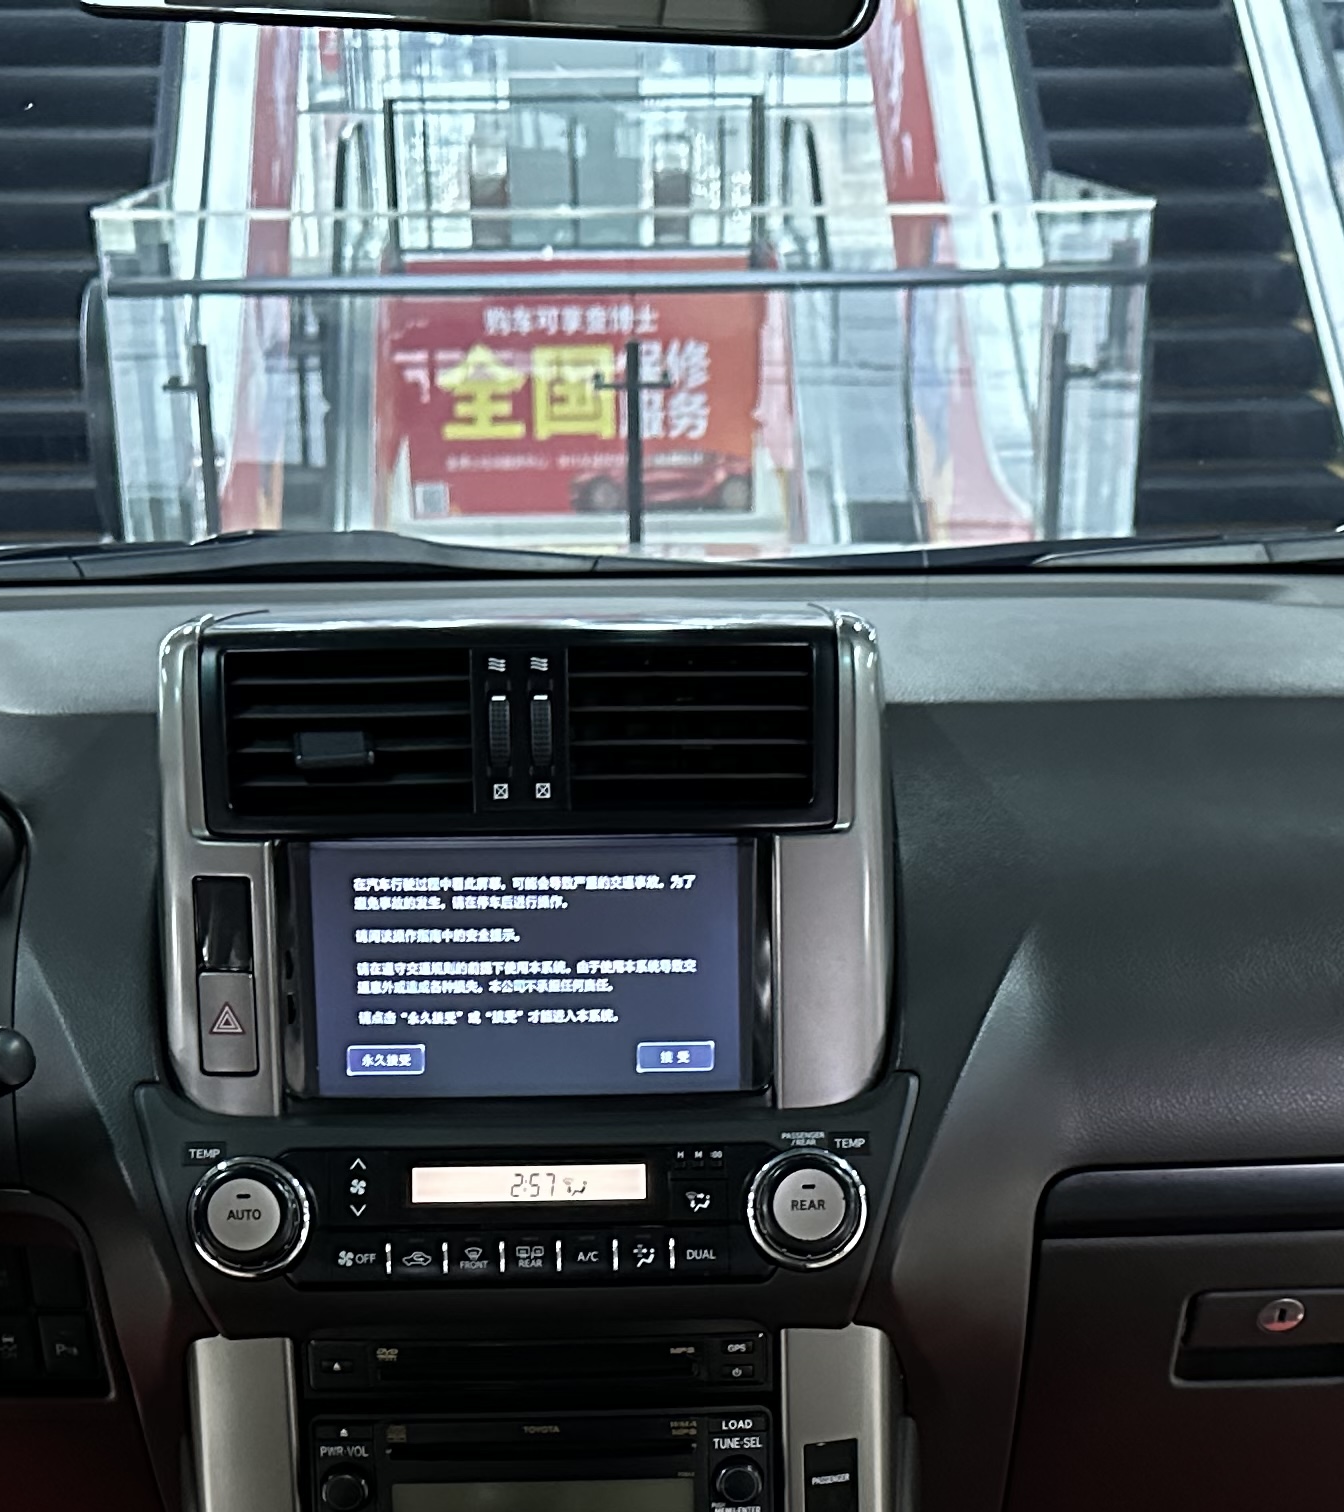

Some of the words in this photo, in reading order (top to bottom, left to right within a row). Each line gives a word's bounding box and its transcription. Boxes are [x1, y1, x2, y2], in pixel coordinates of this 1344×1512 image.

[436, 343, 617, 441] 全国
[834, 1138, 865, 1149] TEMP
[189, 1148, 221, 1159] TEMP
[510, 1172, 556, 1198] 2:57
[791, 1200, 826, 1212] REAR
[226, 1208, 262, 1221] AUTO
[356, 1253, 377, 1265] OFF
[577, 1251, 599, 1262] A/C
[686, 1249, 716, 1260] DUAL
[460, 1260, 488, 1269] FRONT
[518, 1259, 543, 1268] REAR
[727, 1343, 746, 1352] GPS
[722, 1419, 753, 1430] LOAD
